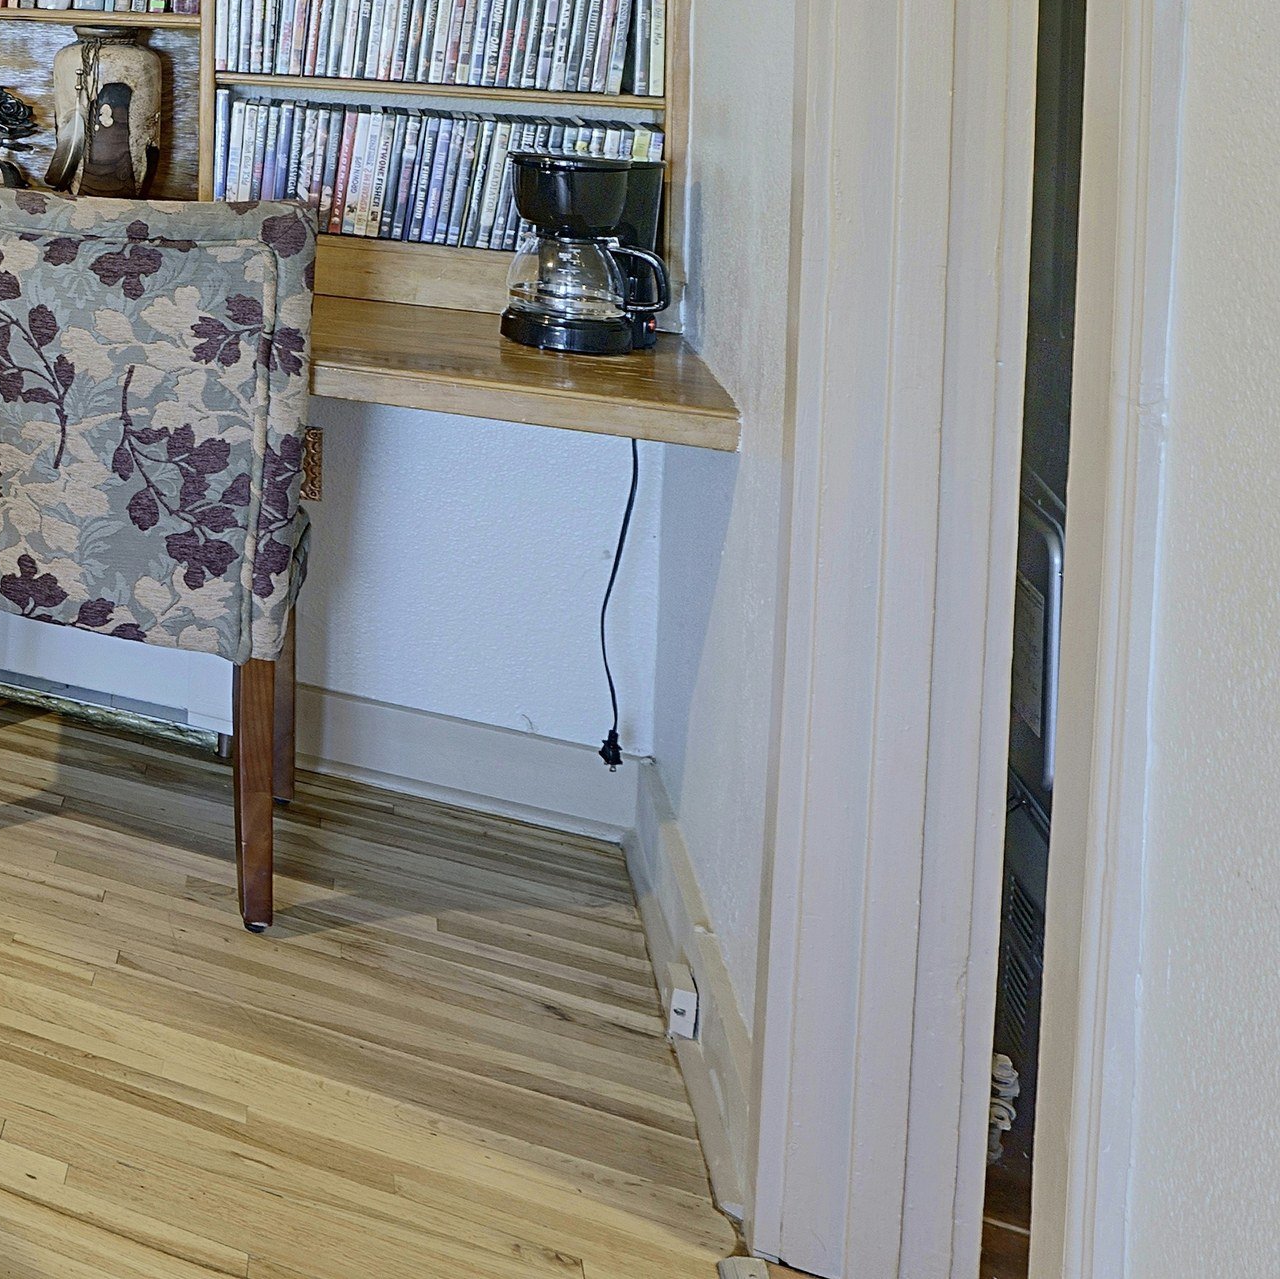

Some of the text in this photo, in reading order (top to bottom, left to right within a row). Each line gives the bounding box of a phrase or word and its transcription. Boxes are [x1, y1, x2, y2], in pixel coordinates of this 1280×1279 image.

[589, 12, 600, 31] FIFTH
[489, 36, 500, 57] TWO
[585, 31, 597, 61] ELEMENT
[653, 32, 662, 46] Map
[287, 171, 299, 194] VEGAS
[350, 170, 360, 194] GROWN
[372, 177, 384, 208] FISHER
[484, 161, 502, 213] GLADIATOR
[415, 191, 427, 219] BLOOD
